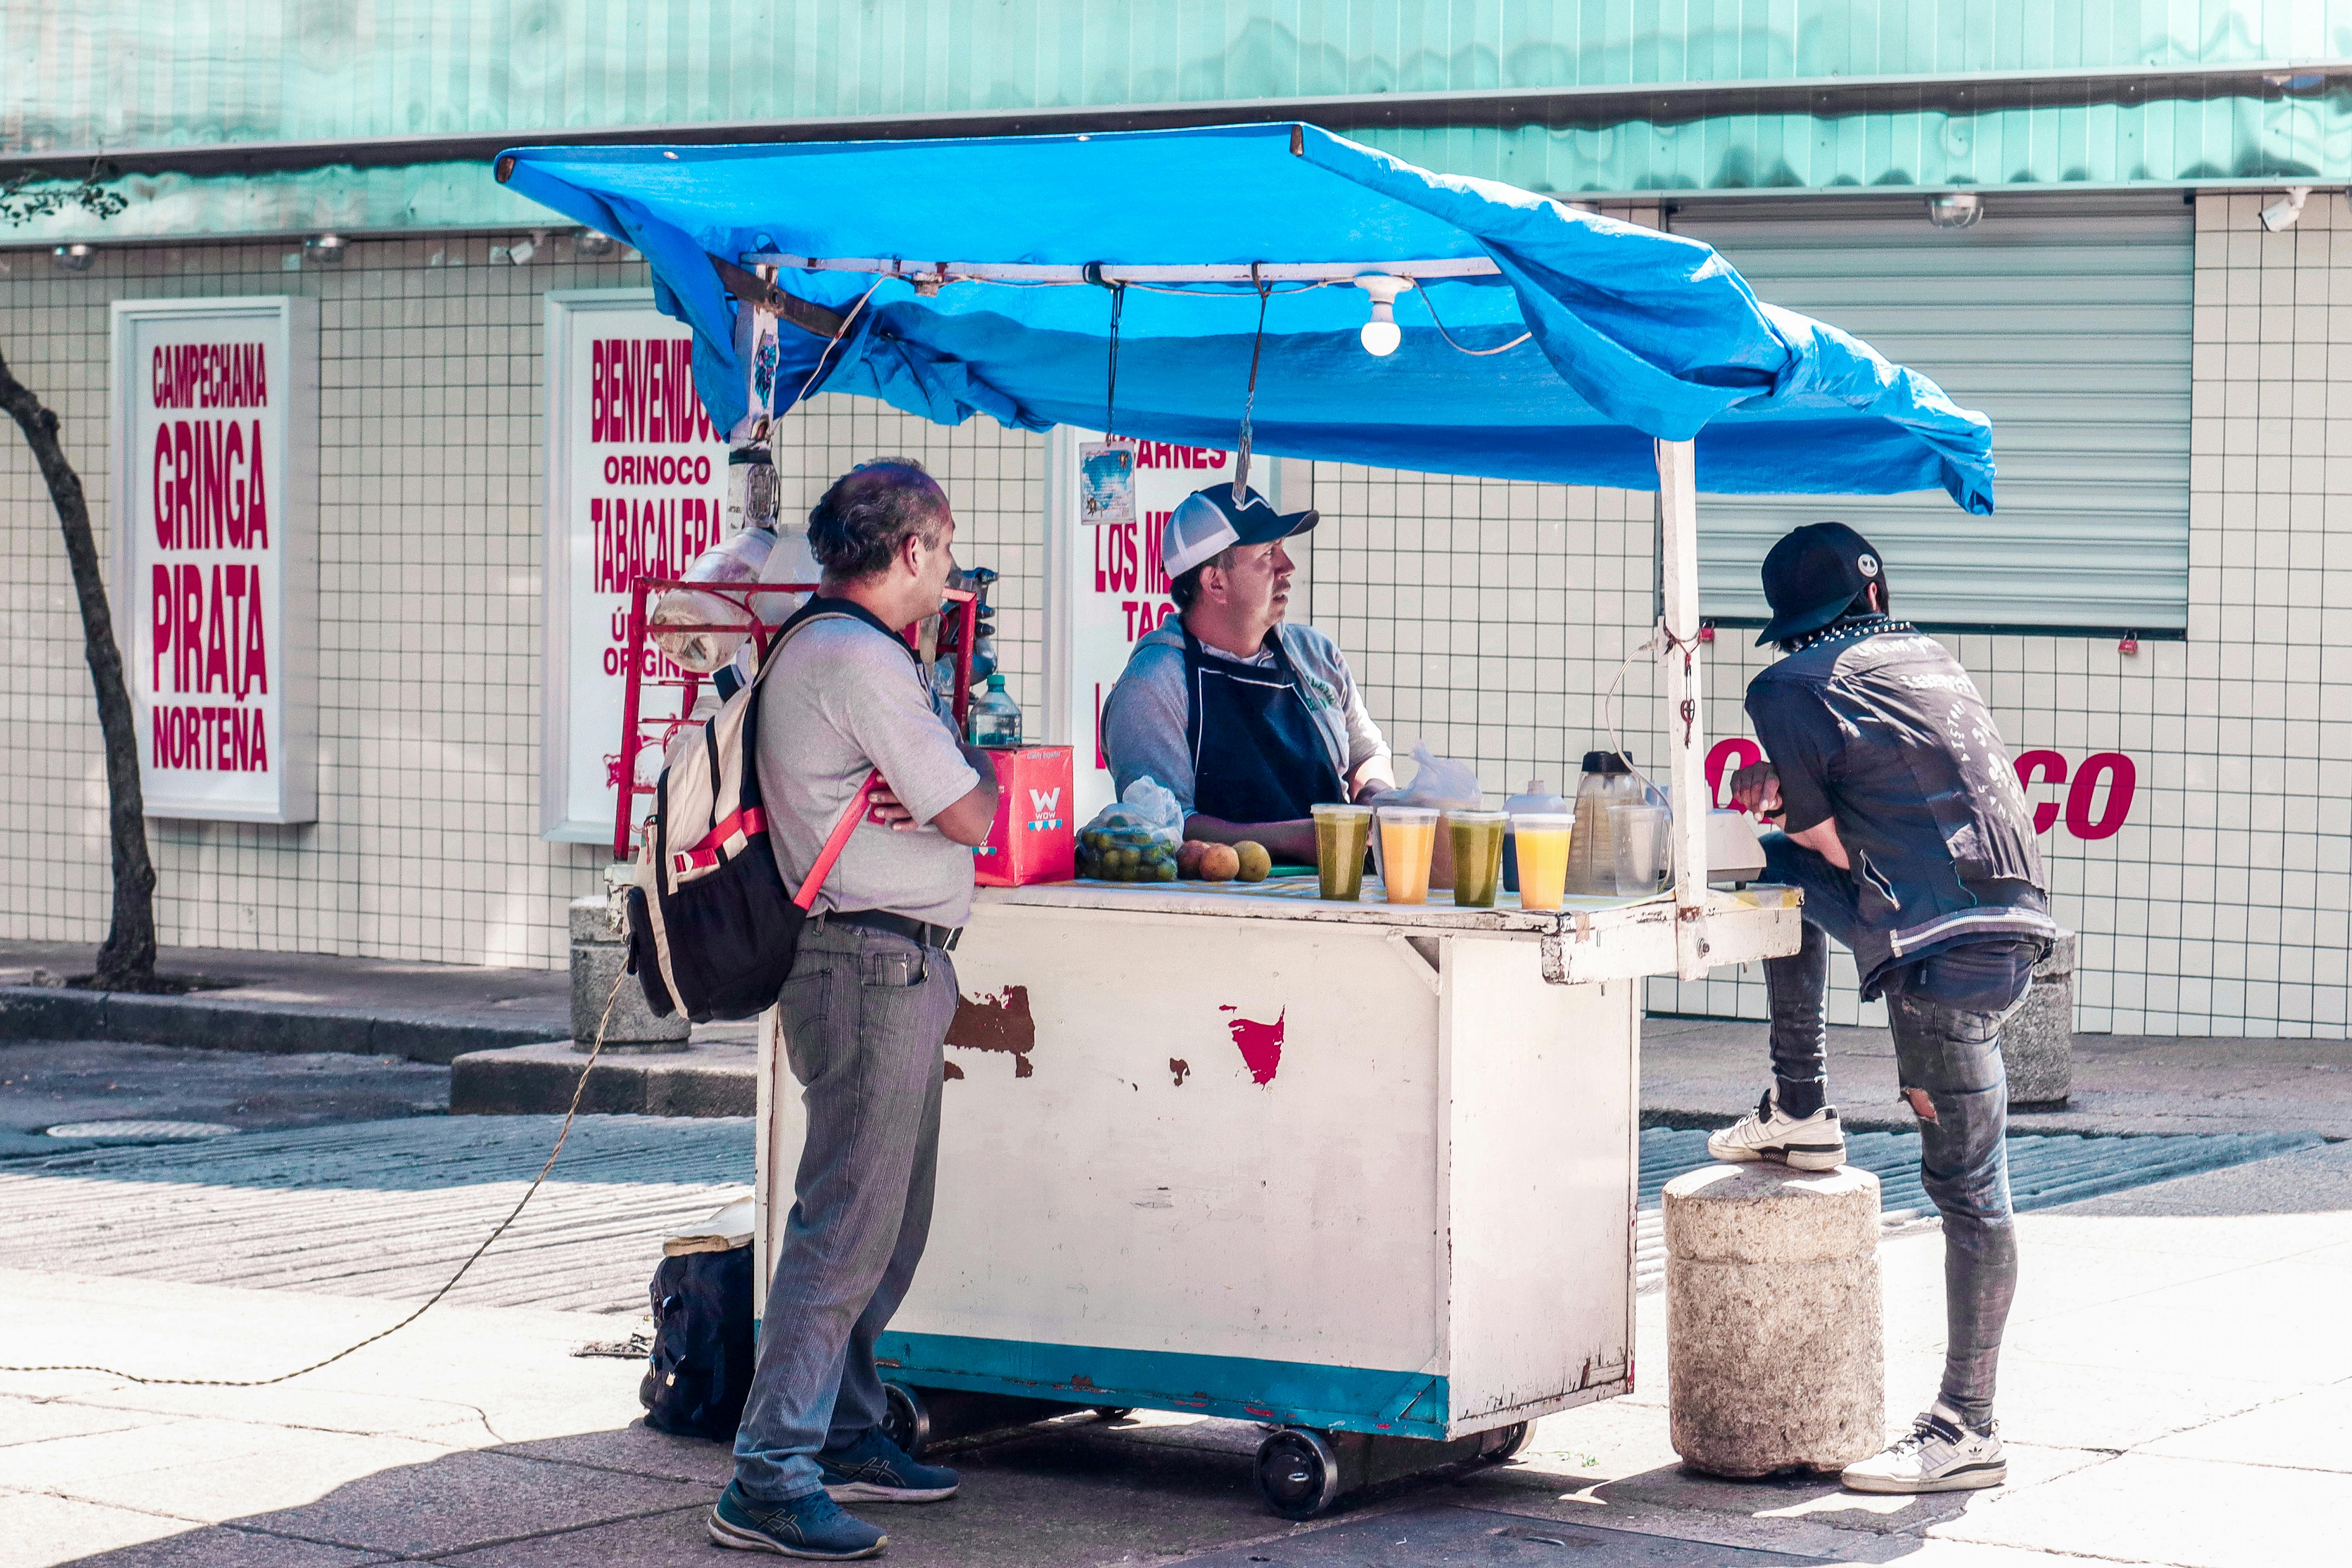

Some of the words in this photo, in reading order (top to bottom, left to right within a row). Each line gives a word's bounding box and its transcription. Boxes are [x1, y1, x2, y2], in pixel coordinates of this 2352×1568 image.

[154, 343, 267, 408] CAMPECHANA
[592, 339, 721, 443] BIENVENID
[154, 419, 268, 550] GRINGA
[604, 456, 711, 485] ORINOCO
[1095, 523, 1138, 593] LOS
[153, 564, 268, 695] PIRATA
[153, 691, 268, 772] NORTEÑA
[1029, 787, 1060, 812] W
[1035, 811, 1056, 820] WOW
